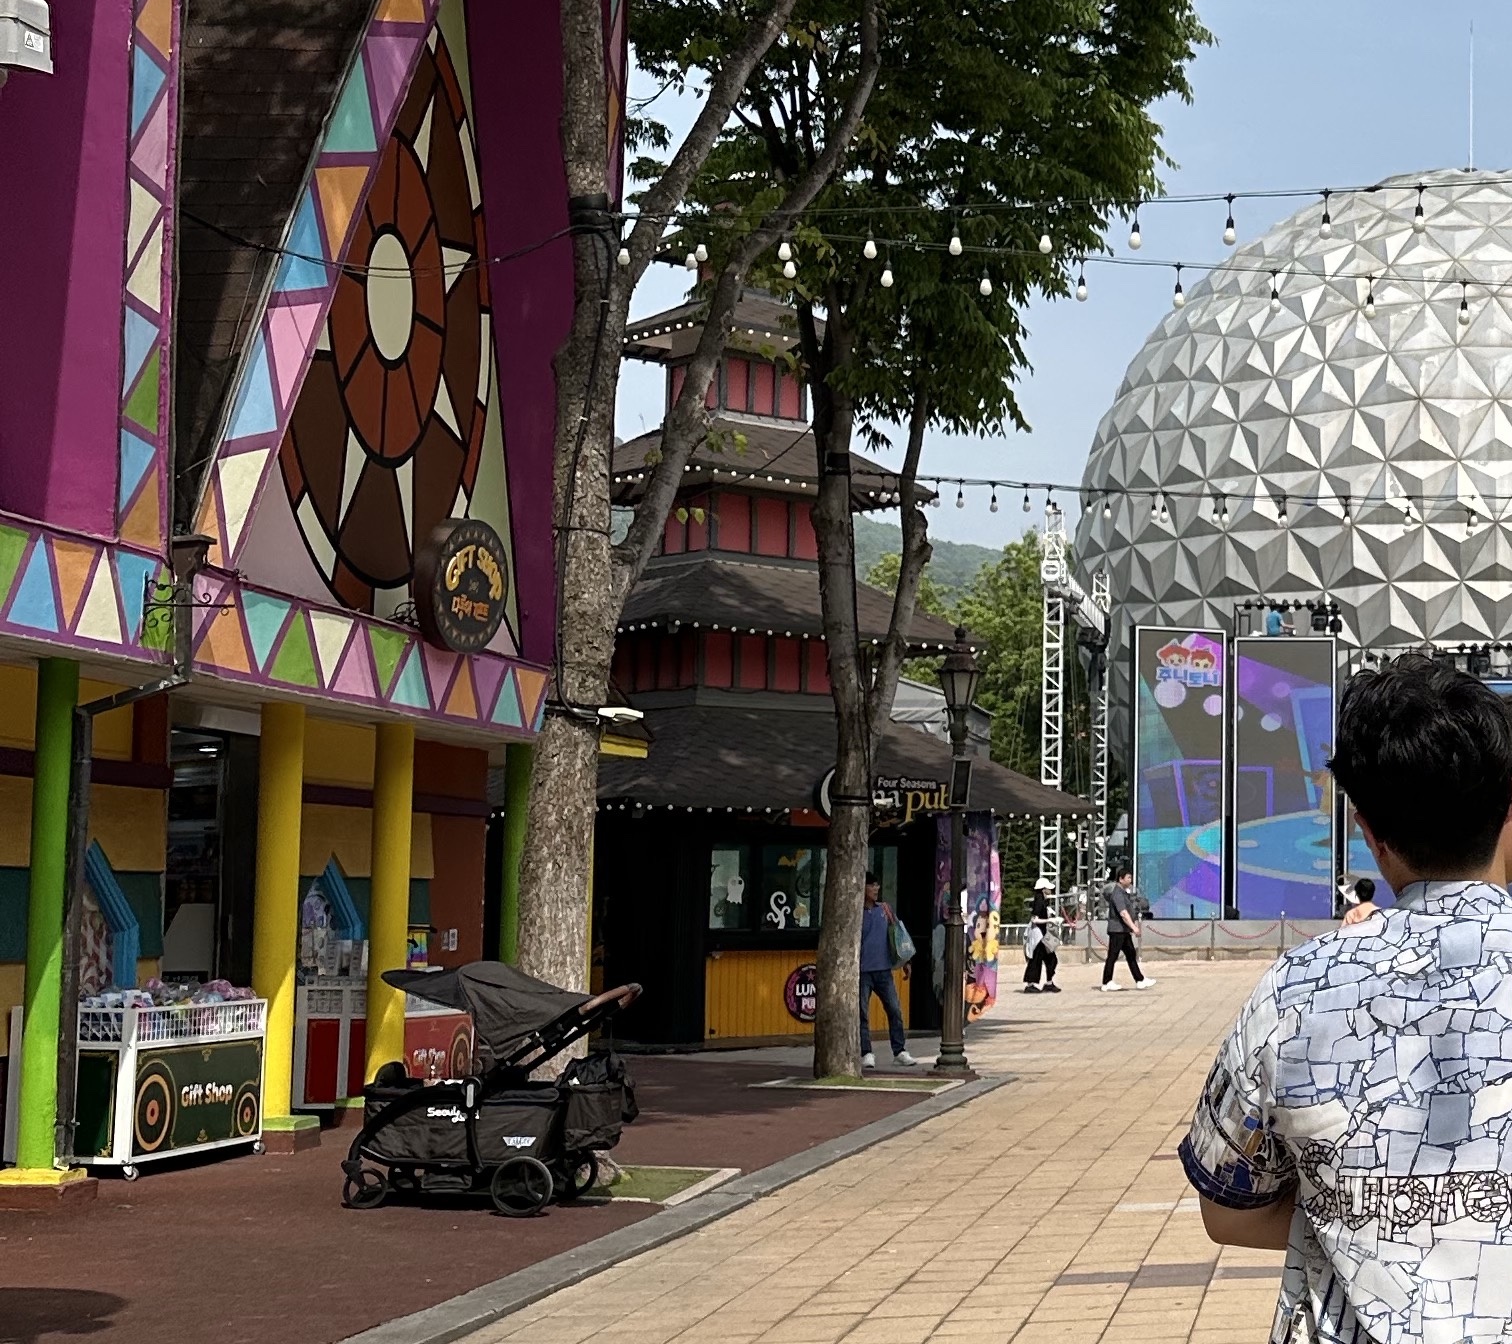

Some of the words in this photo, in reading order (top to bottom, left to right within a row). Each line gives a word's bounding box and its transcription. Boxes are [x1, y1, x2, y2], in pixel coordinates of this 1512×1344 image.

[445, 544, 477, 591] GIFT
[878, 776, 898, 788] Four
[900, 777, 937, 789] Seasons
[795, 983, 816, 996] LUN
[181, 1083, 203, 1107] Gift
[205, 1082, 233, 1105] Shop
